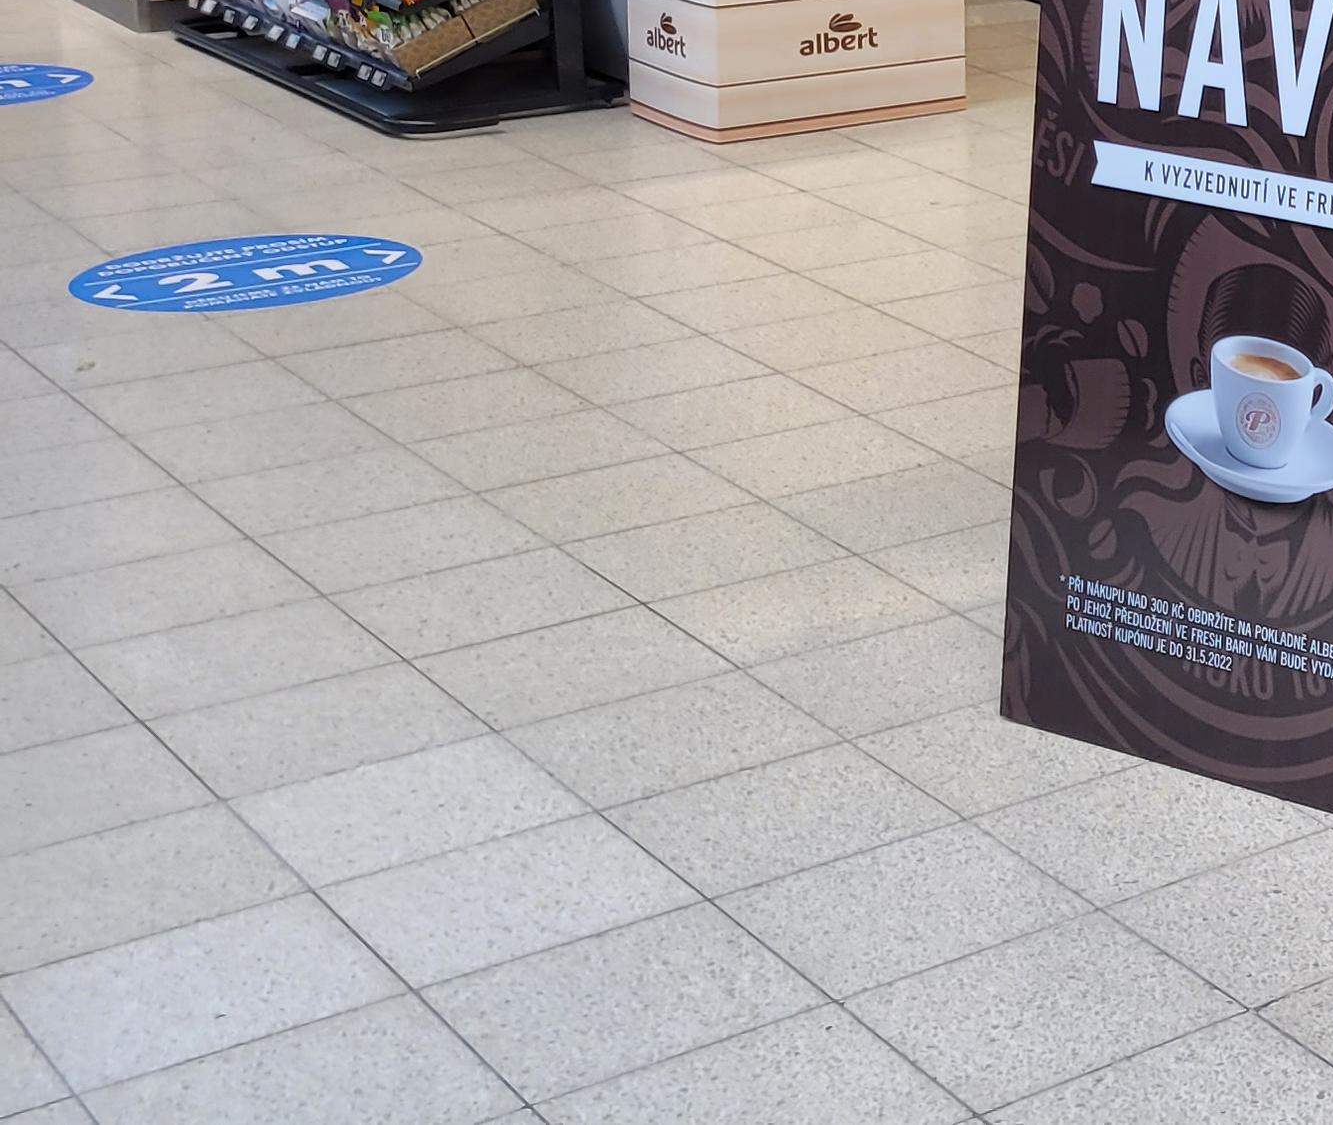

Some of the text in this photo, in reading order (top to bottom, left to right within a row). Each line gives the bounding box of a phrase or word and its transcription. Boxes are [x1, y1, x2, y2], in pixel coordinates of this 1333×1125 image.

[646, 26, 687, 59] albert
[799, 26, 879, 57] albert
[1144, 160, 1154, 182] K
[1161, 163, 1269, 205] VYZVEDNUTÍ
[1277, 184, 1298, 209] VE
[158, 272, 234, 294] 2
[251, 259, 351, 281] m
[1066, 594, 1081, 613] PO
[1082, 596, 1113, 621] JEHOŽ
[1114, 606, 1173, 636] PŘEDLOŽENÍ
[1175, 623, 1188, 641] VE
[1190, 627, 1223, 650] FRESH
[1225, 638, 1253, 658] BARU
[1255, 642, 1277, 665] VÁM
[1280, 650, 1308, 673] BUDE
[1067, 575, 1085, 594] PŘI
[1086, 579, 1125, 605] NÁKUPU
[1127, 590, 1148, 610] NAD
[1150, 597, 1169, 616] 300
[1171, 598, 1185, 620] KČ
[1187, 606, 1236, 633] OBDRŽÍTE
[1237, 621, 1252, 637] NA
[1254, 624, 1308, 653] POKLADNĚ
[1114, 626, 1154, 651] KUPÓNU
[1155, 638, 1168, 654] JE
[1169, 640, 1184, 658] DO
[1184, 643, 1233, 672] 31.5.2022
